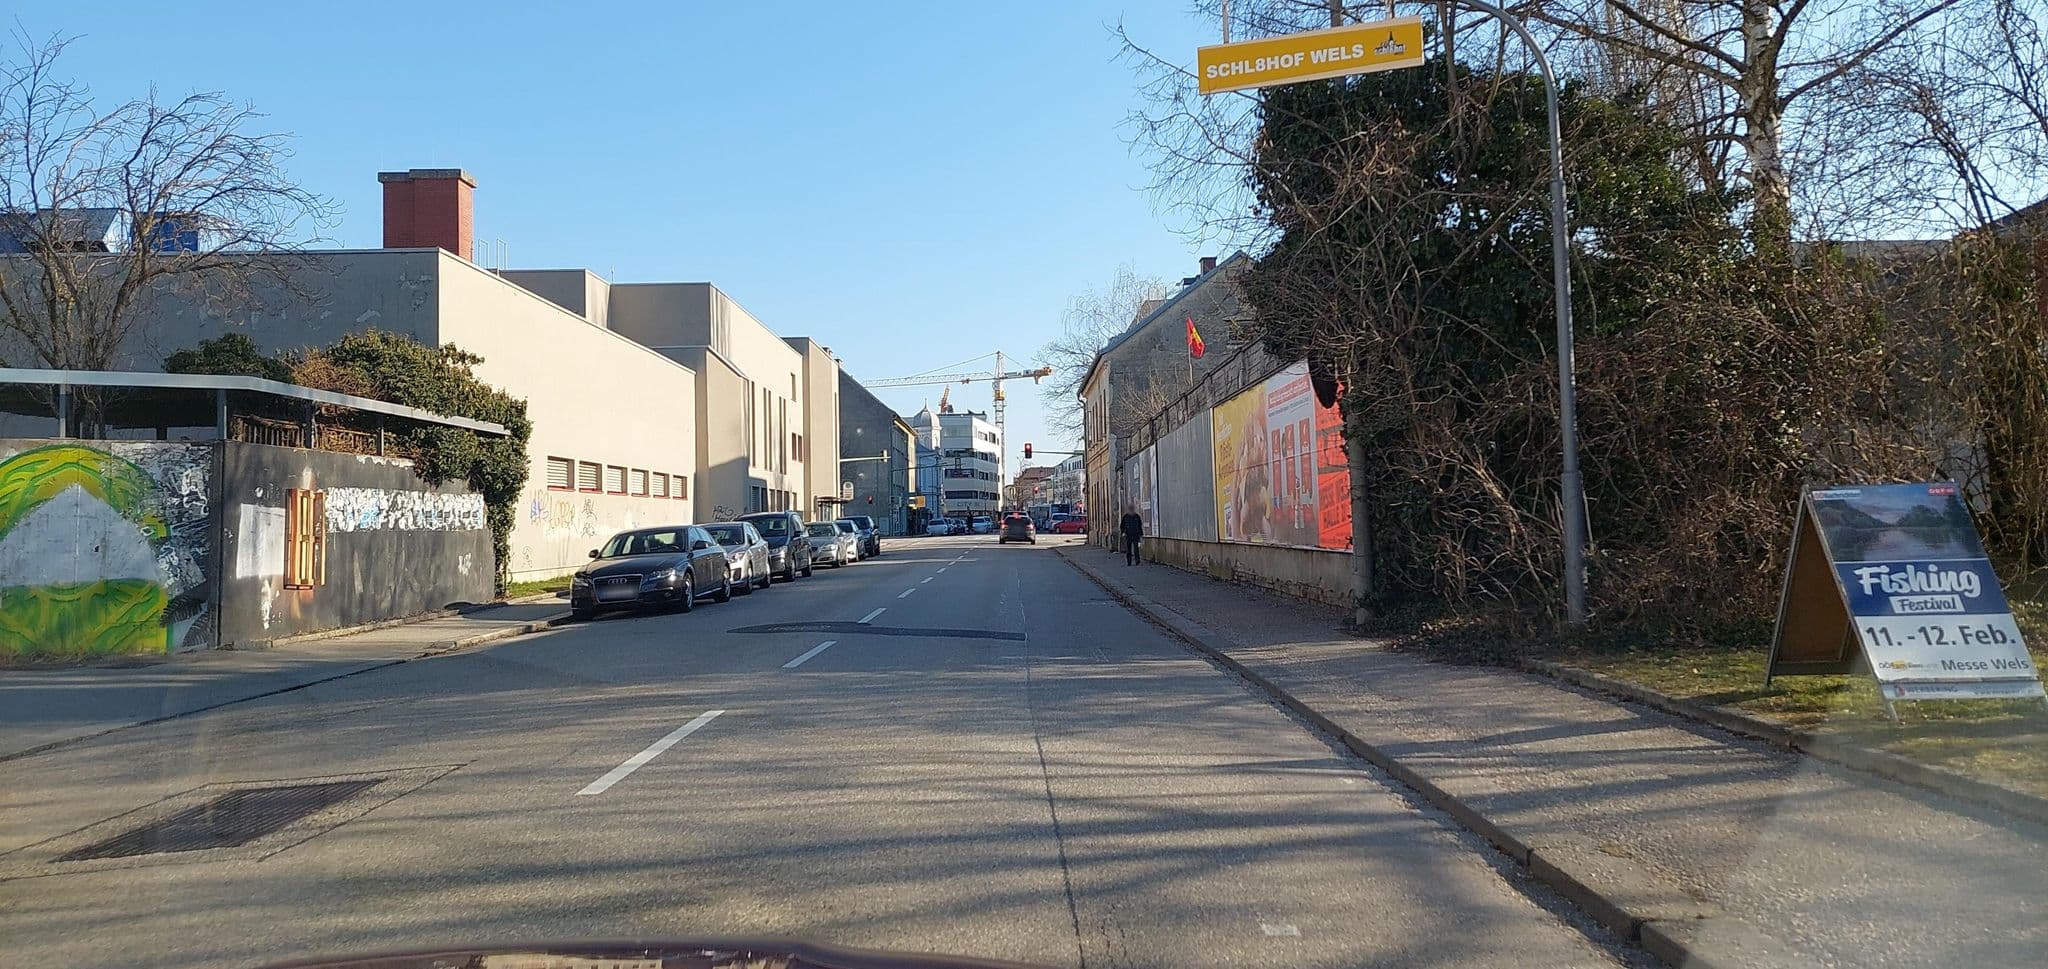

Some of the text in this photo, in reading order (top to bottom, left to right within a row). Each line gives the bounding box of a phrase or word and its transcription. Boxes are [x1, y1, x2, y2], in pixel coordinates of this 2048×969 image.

[1206, 44, 1364, 79] SCHL8HOF WELS
[1853, 563, 1982, 598] Fishing
[1898, 598, 1957, 612] Festival
[1865, 626, 1902, 647] 11.
[1918, 625, 1957, 646] 12.
[1959, 623, 2016, 646] Feb.
[1941, 658, 1989, 672] Messe
[1991, 657, 2029, 671] Wels
